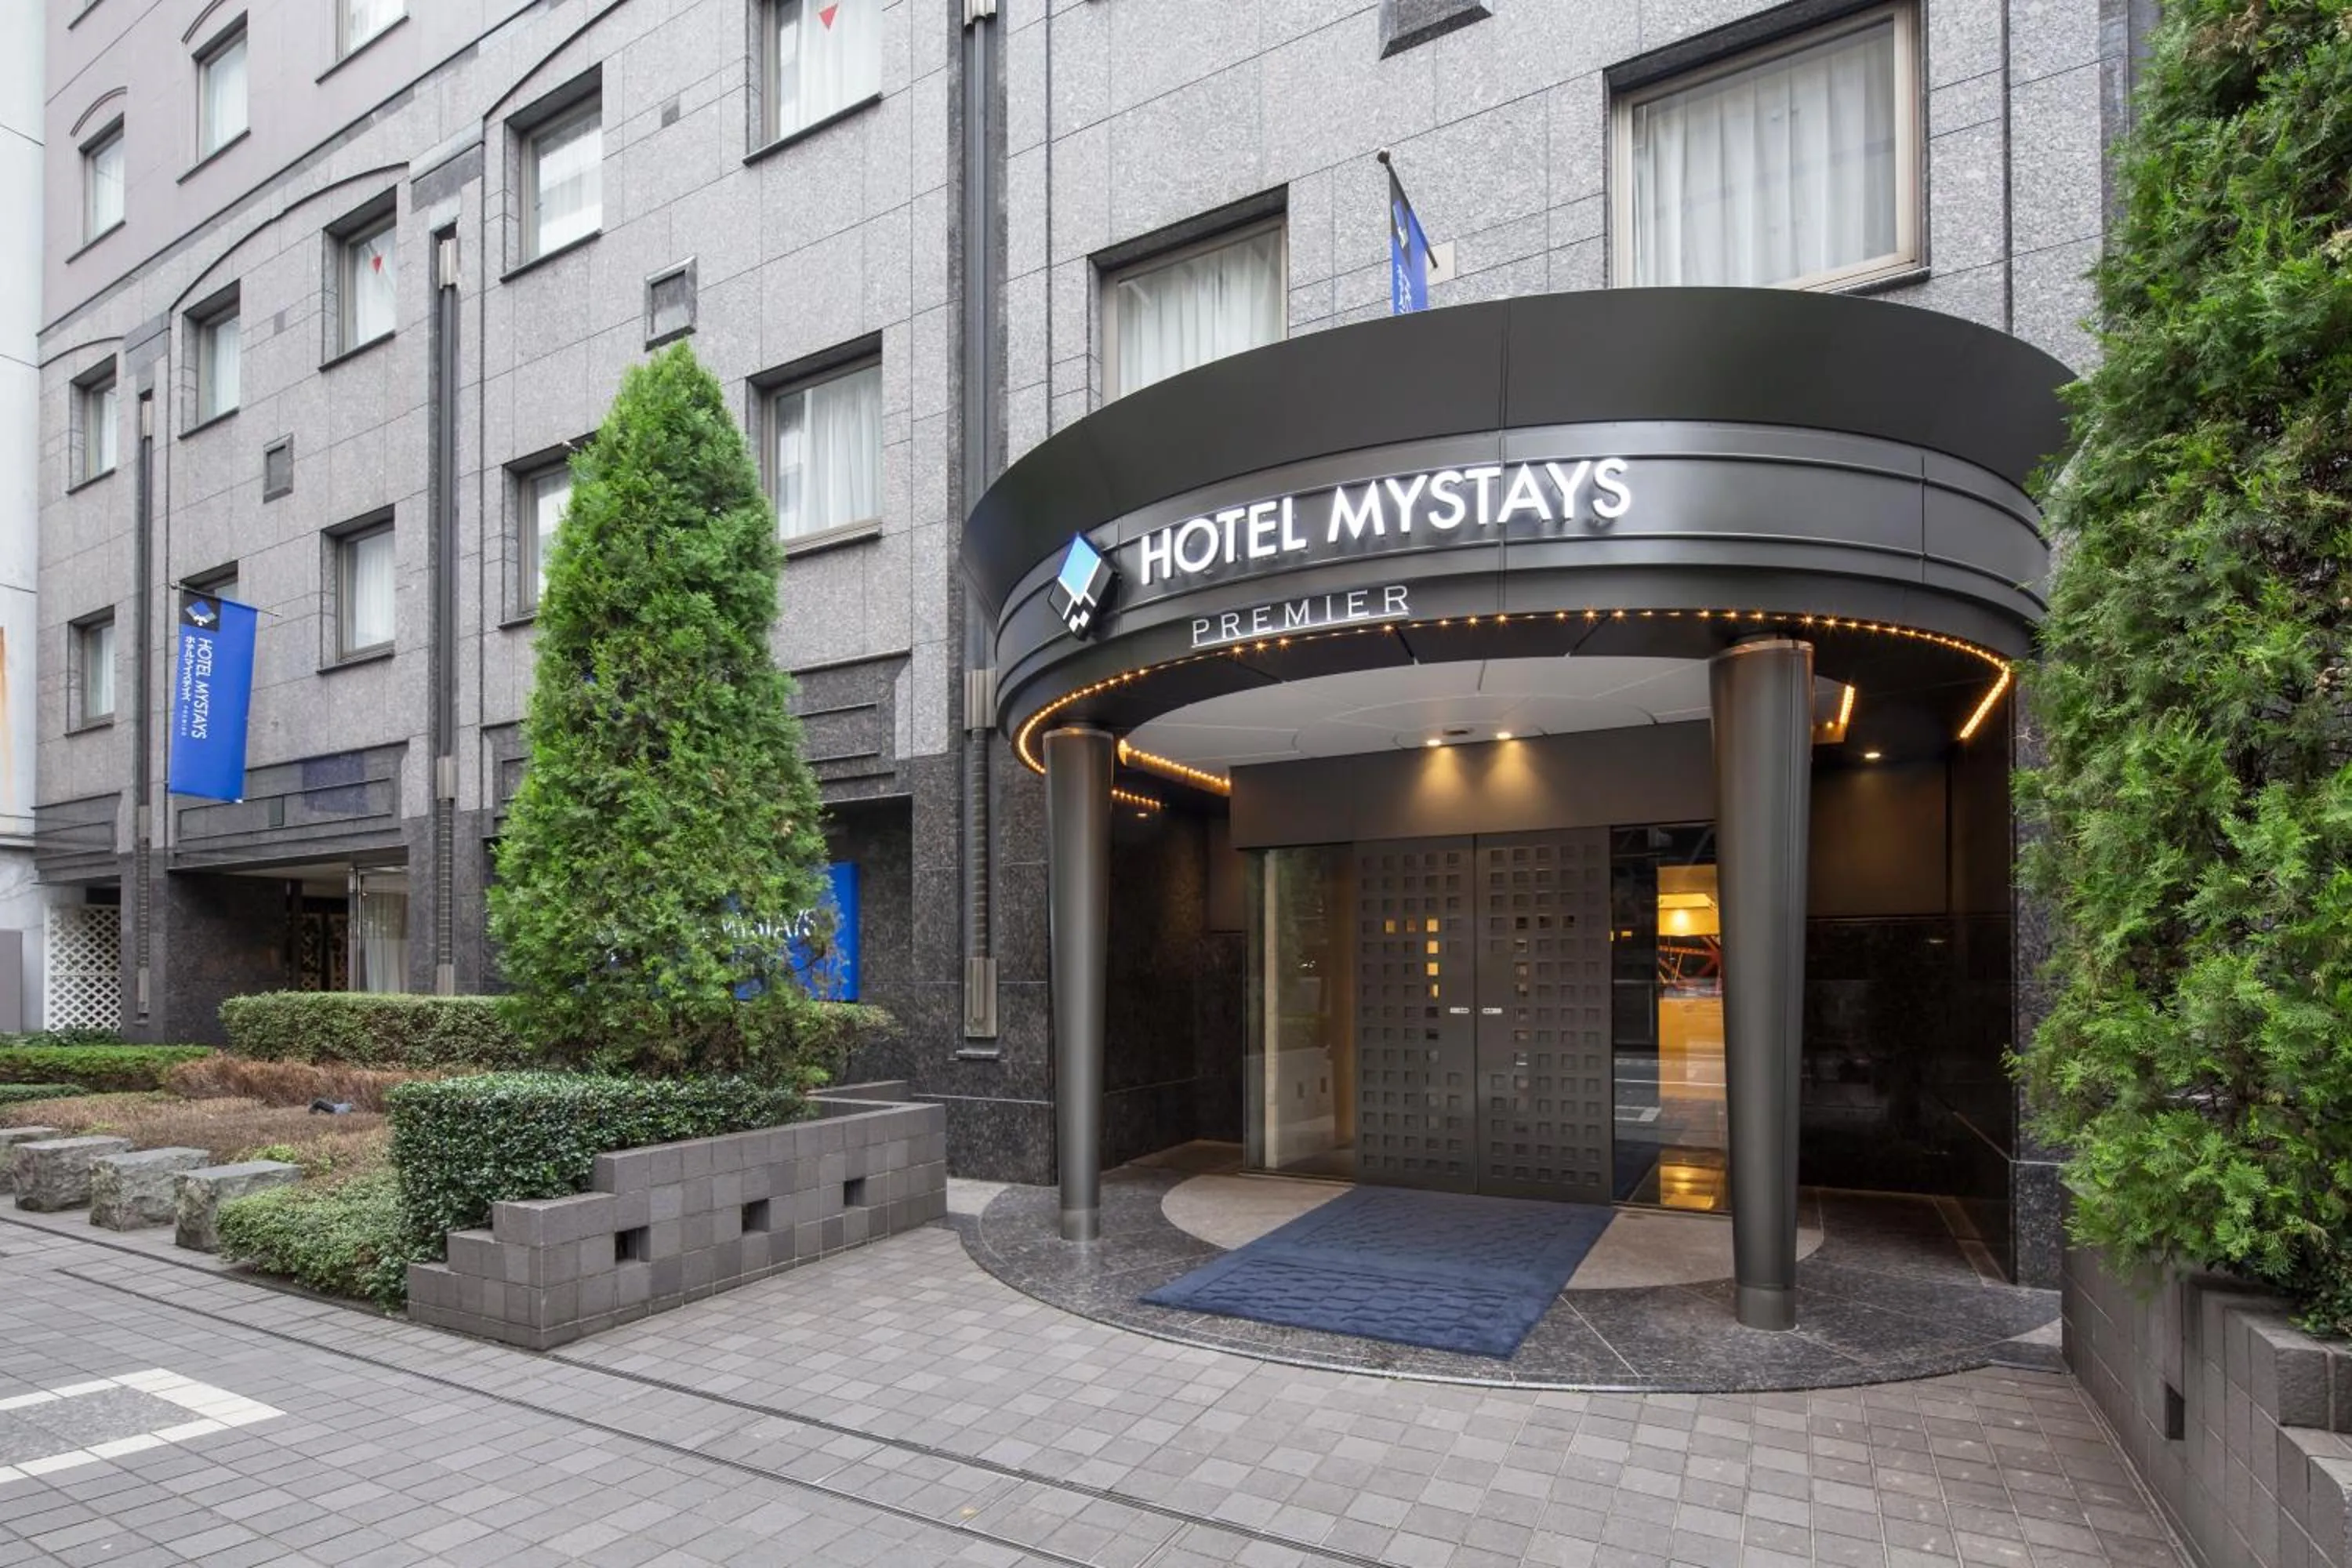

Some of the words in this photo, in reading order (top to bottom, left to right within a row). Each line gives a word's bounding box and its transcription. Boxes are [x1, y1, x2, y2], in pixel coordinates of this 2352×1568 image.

[1141, 497, 1307, 585] HOTEL
[1327, 457, 1632, 543] MYSTAYS
[1191, 585, 1409, 645] PREMIER
[195, 637, 213, 677] HOTEL
[191, 680, 210, 739] MYSTAYS
